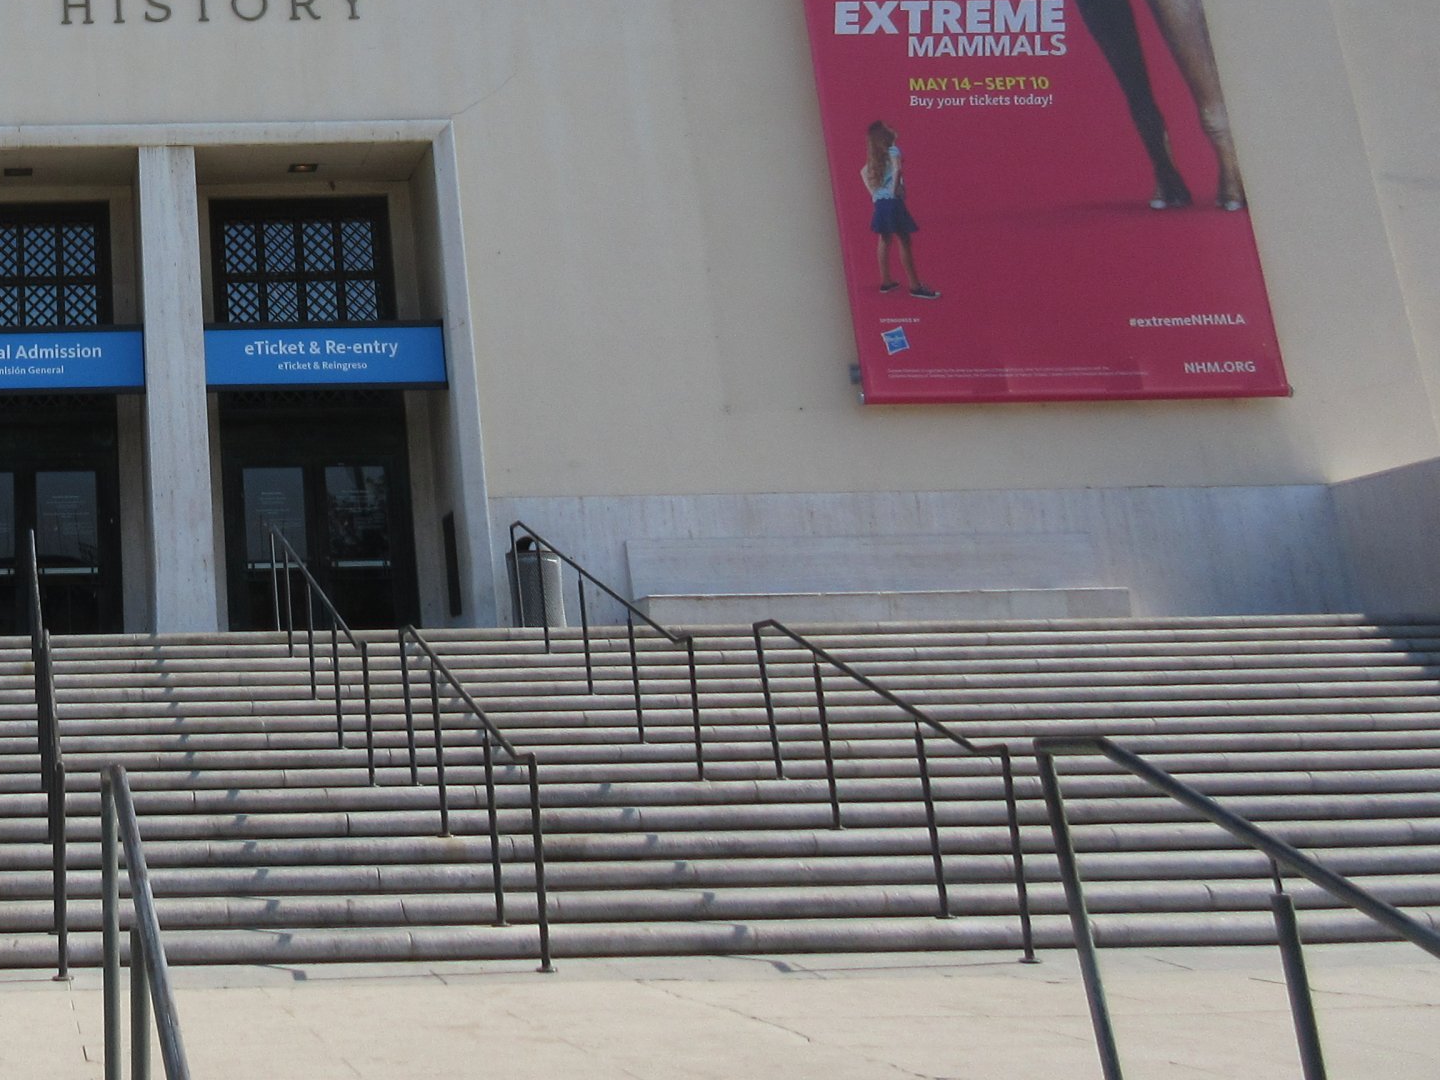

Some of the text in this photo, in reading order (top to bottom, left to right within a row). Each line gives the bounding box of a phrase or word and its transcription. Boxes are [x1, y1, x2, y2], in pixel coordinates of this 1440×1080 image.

[907, 33, 1068, 58] MAMMALS
[909, 77, 948, 92] MAY
[1029, 76, 1050, 90] 10
[909, 93, 1053, 109] Buy your tickets today!
[1129, 314, 1246, 327] #extremeNHMLA
[15, 343, 102, 359] Admission
[244, 339, 398, 358] eTicket & Re-entry
[27, 365, 64, 375] General
[277, 360, 367, 372] eTicket & Reingreso
[1184, 361, 1256, 374] NHM.ORG
